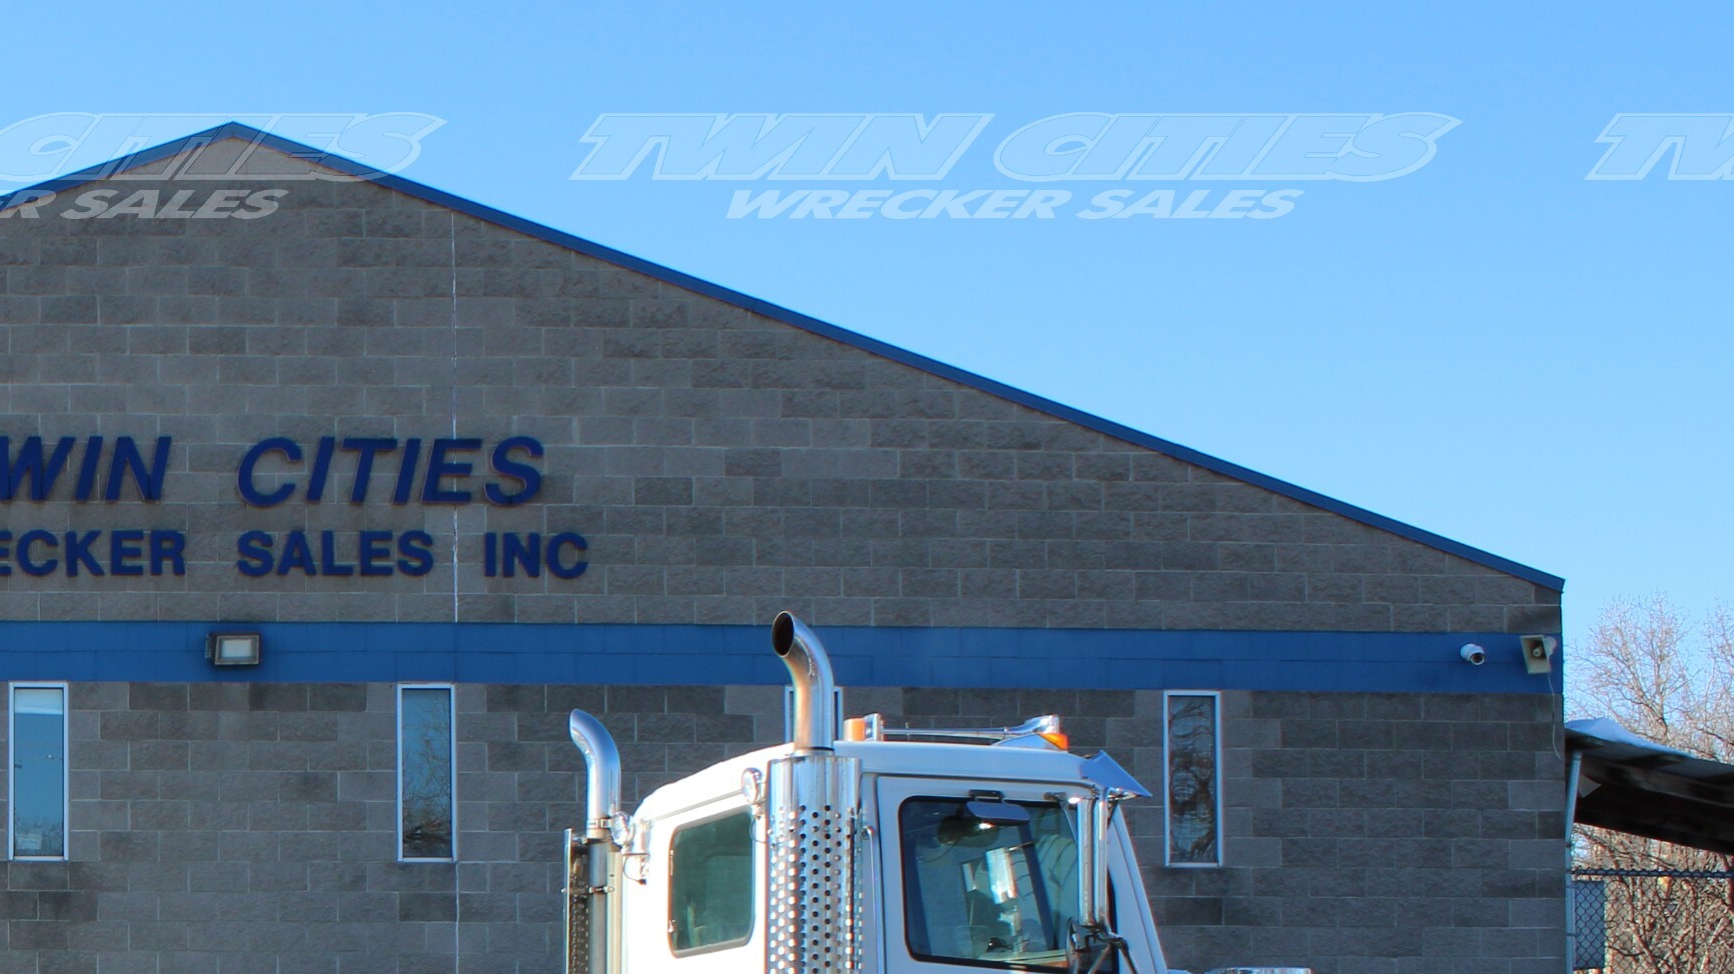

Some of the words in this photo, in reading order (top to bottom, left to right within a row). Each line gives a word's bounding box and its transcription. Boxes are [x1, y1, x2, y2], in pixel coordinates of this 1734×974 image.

[235, 436, 545, 508] CITIES
[236, 529, 435, 577] SALES
[483, 531, 590, 580] INC
